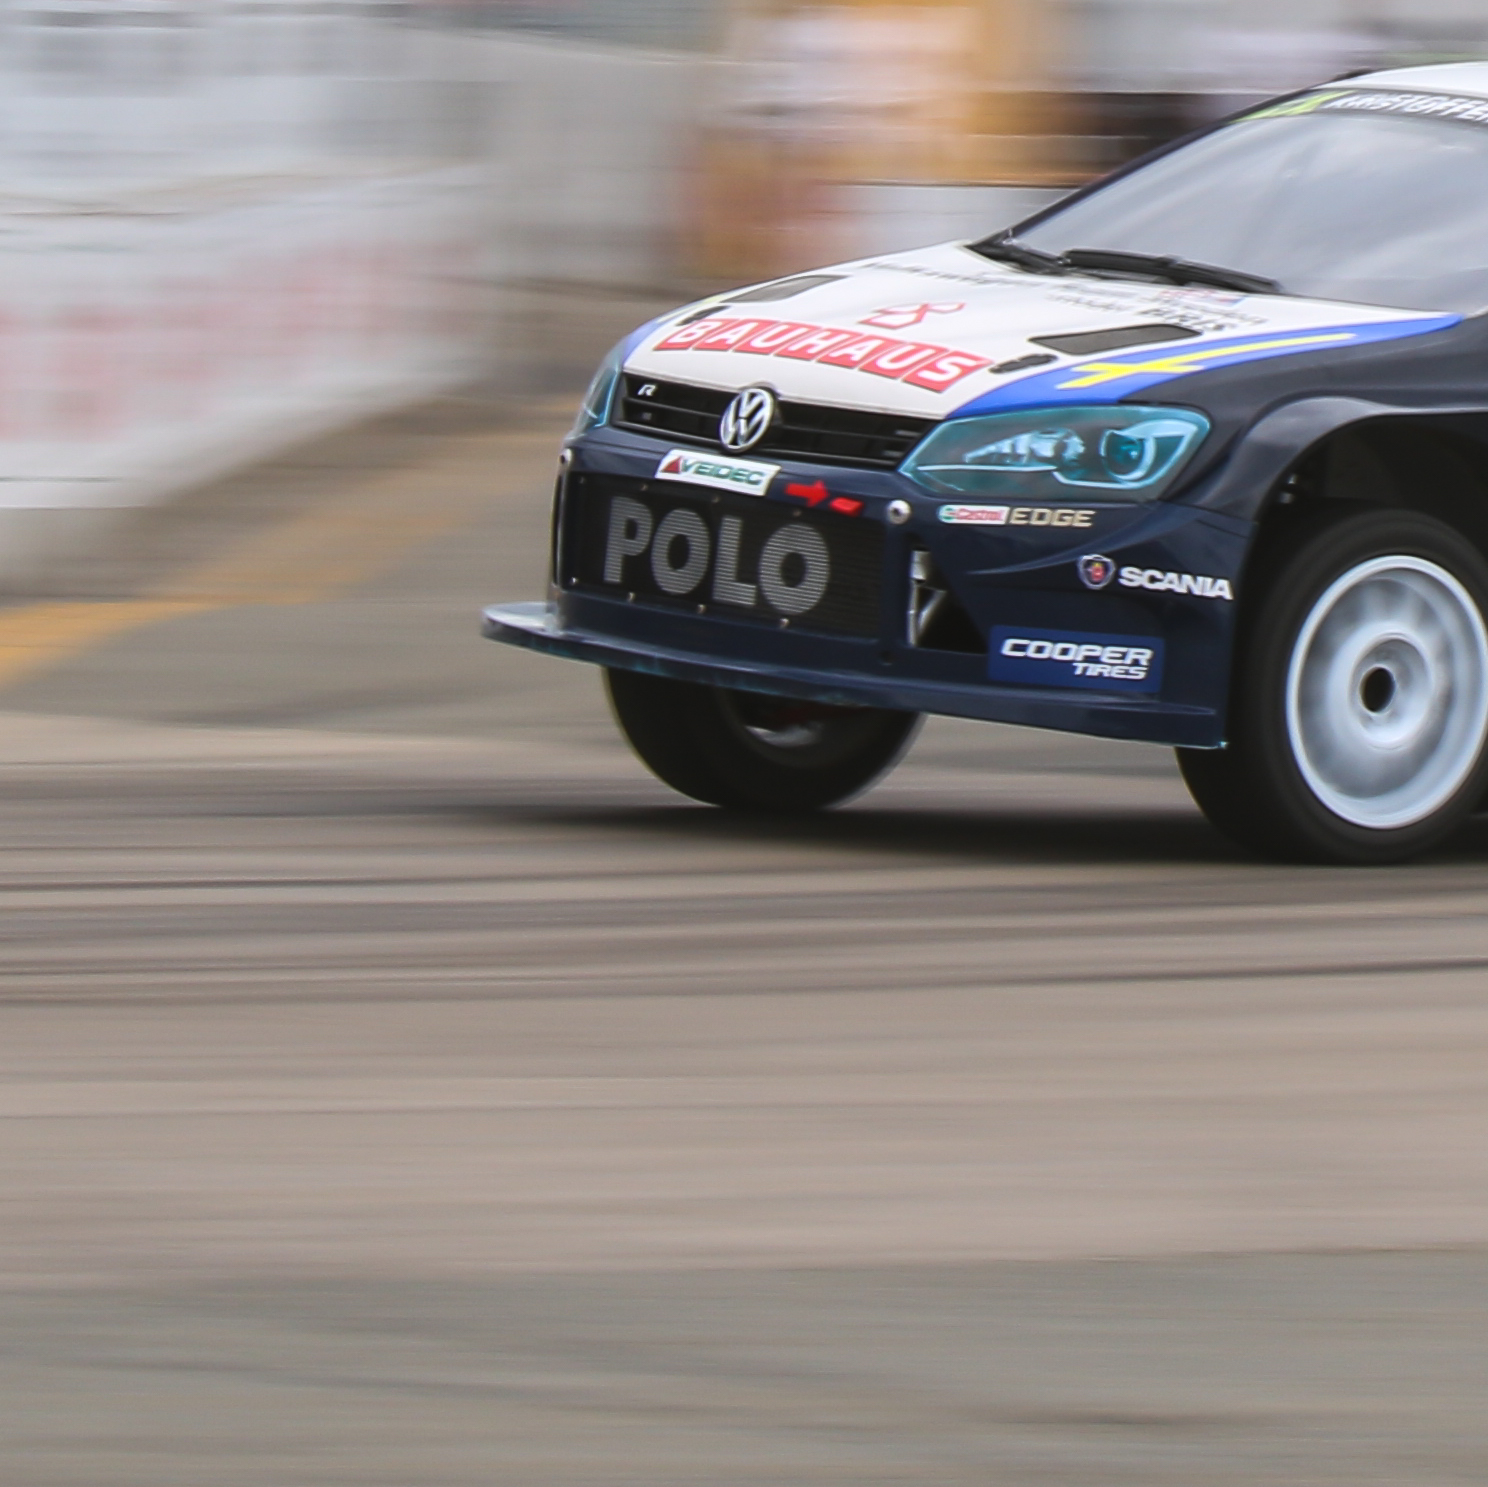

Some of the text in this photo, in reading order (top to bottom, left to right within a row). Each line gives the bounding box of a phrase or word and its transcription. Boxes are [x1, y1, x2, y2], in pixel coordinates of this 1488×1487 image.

[667, 320, 981, 382] BAUHAUS
[1009, 507, 1097, 528] EDGE
[603, 495, 831, 615] POLO
[1118, 566, 1234, 601] SCANIA
[1001, 637, 1154, 667] COOPER
[1072, 662, 1149, 681] TIRES
